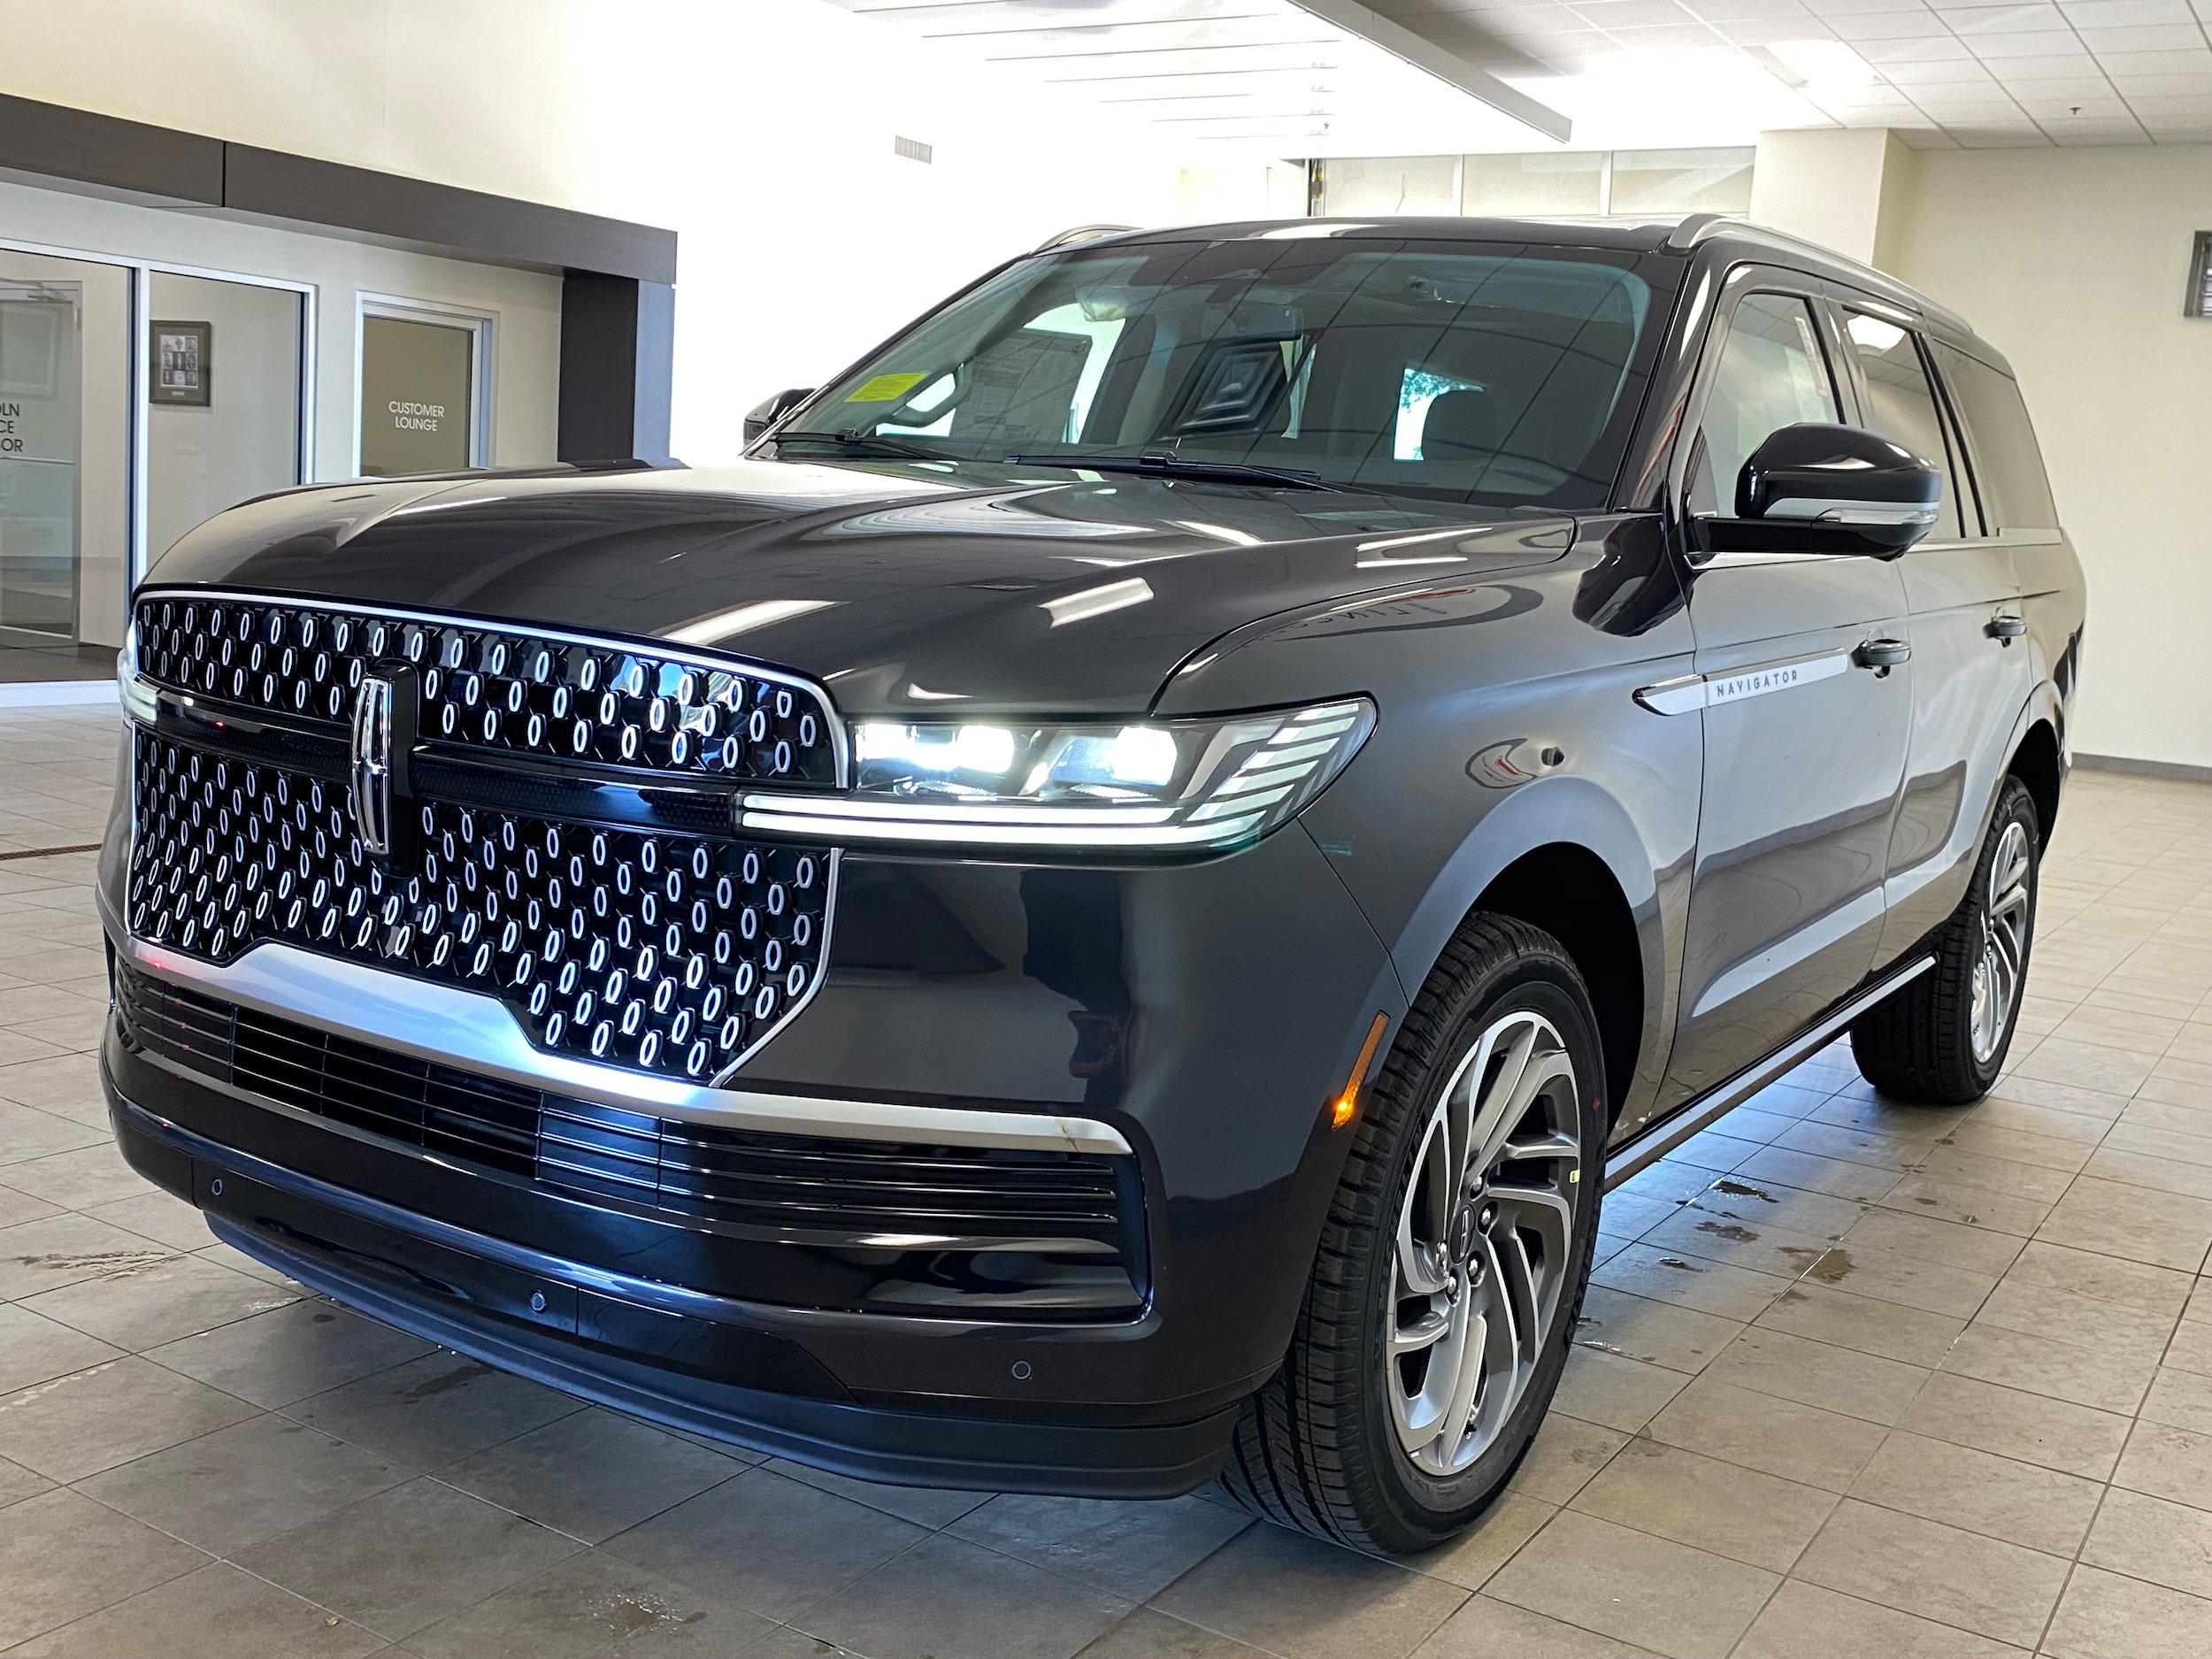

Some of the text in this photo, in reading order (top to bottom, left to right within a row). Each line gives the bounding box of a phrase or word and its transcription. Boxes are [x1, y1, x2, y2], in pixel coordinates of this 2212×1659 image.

[0, 402, 19, 417] LN
[388, 401, 444, 418] CUSTOMER
[395, 416, 438, 432] LOUNGE
[1717, 669, 1797, 697] NAVIGATOR
